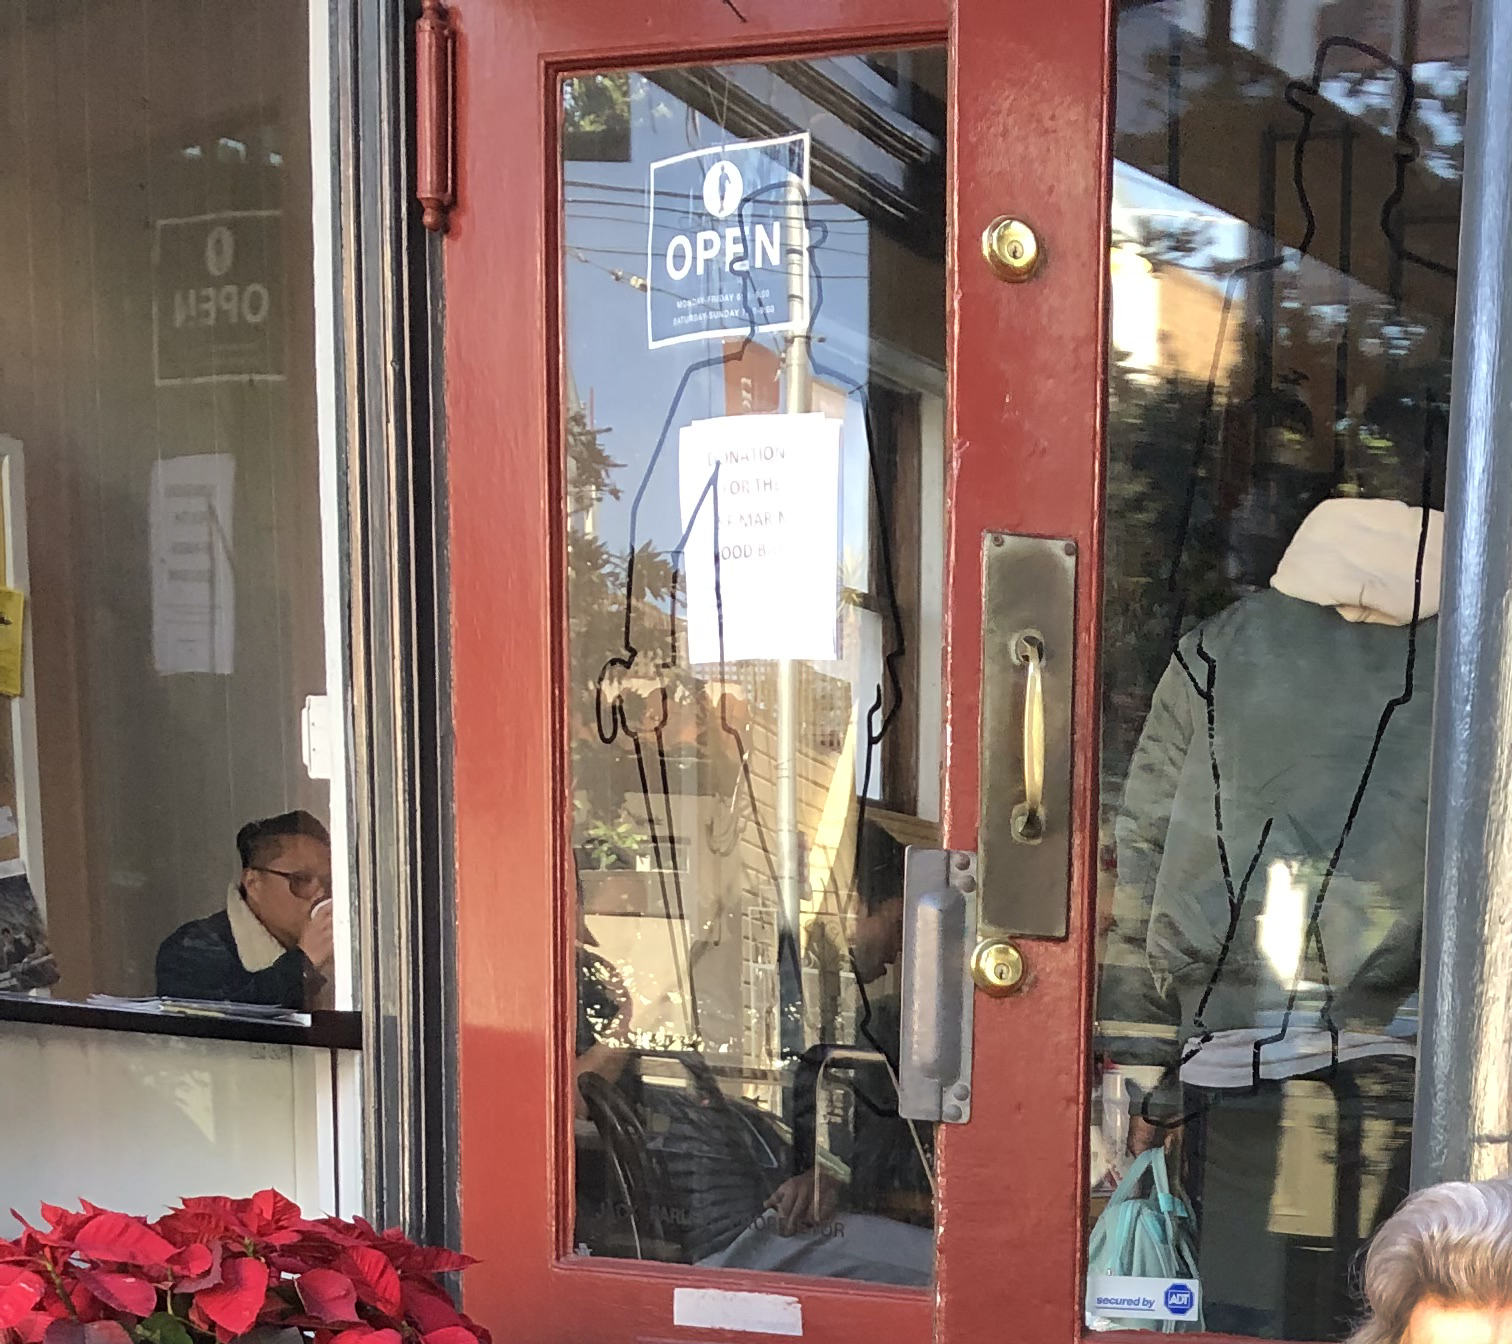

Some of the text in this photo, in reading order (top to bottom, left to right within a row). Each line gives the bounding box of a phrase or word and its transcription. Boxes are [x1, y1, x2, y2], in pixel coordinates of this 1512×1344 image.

[665, 221, 781, 281] OPEN
[722, 480, 750, 496] OR
[739, 511, 786, 527] MARN
[715, 544, 753, 560] OOD
[1096, 1296, 1155, 1309] secured by
[1169, 1293, 1190, 1306] ADT
